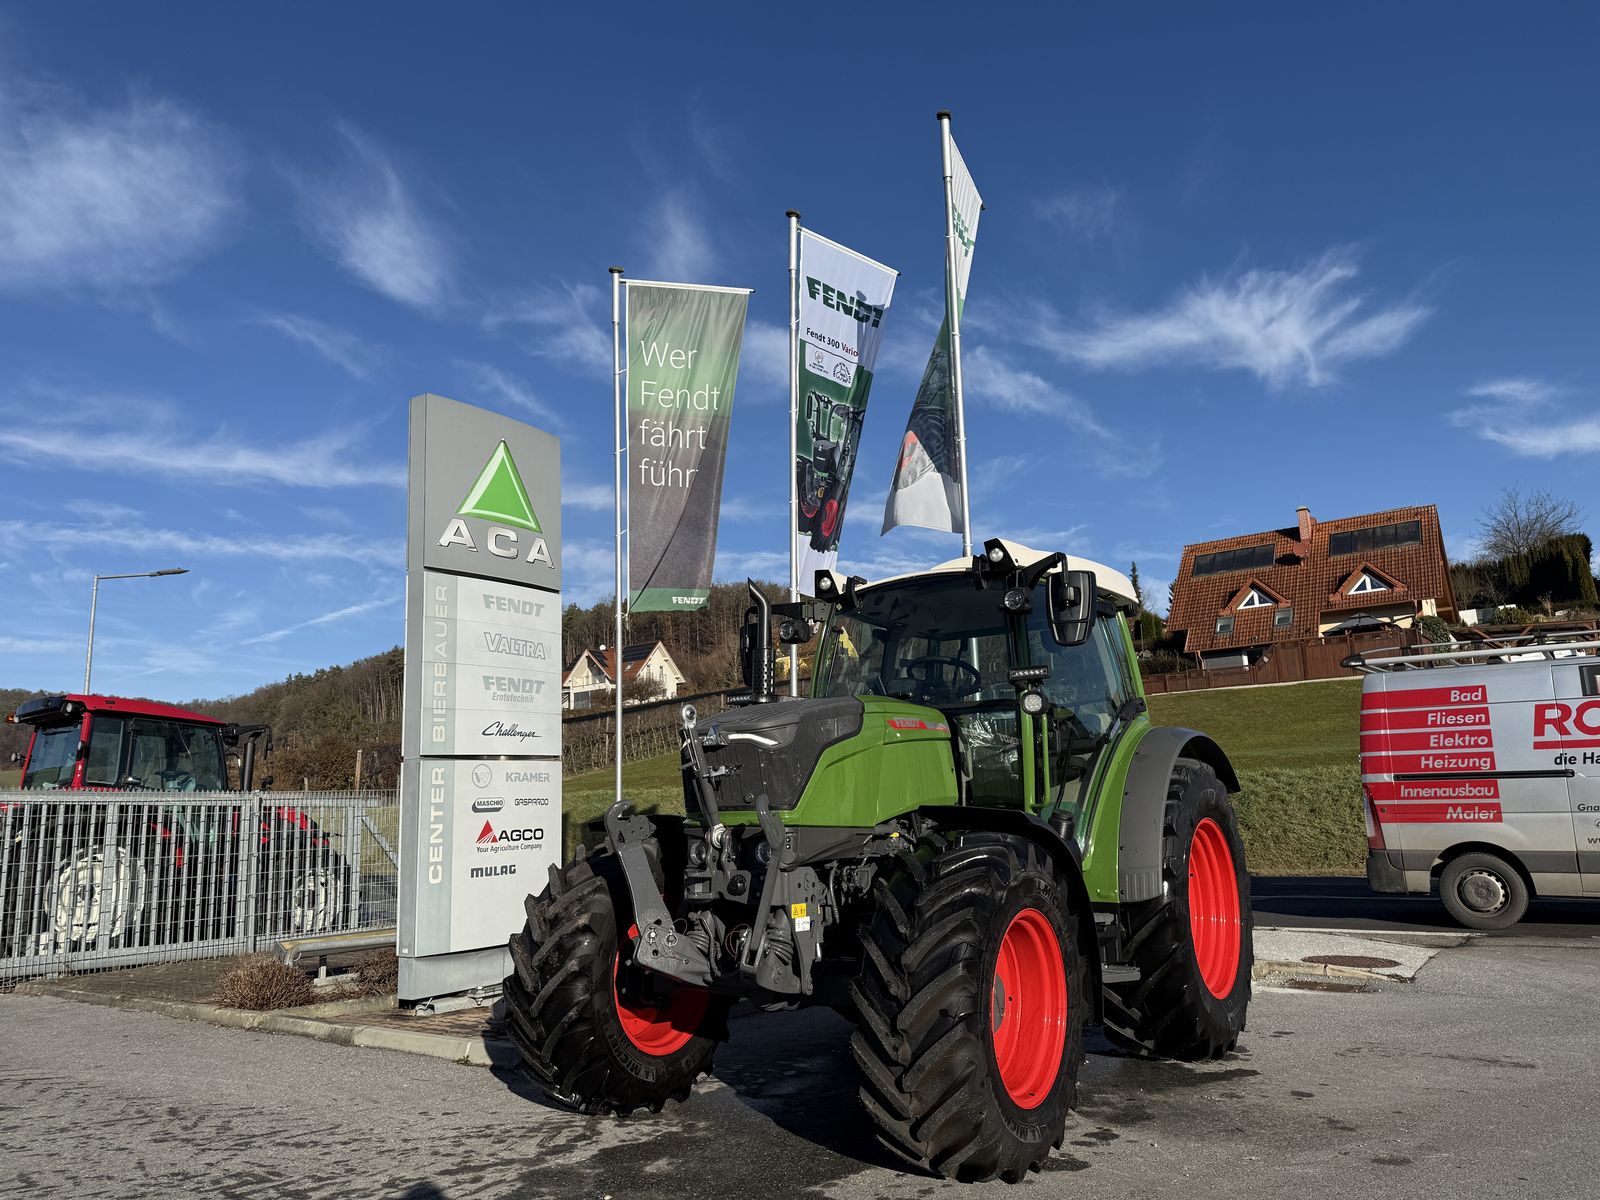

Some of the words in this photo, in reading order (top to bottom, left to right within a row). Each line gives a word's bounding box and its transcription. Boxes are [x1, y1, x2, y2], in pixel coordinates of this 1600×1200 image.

[806, 327, 826, 343] Fendt
[827, 337, 840, 349] 300
[841, 342, 859, 357] Vario
[640, 340, 697, 369] Wer
[641, 380, 720, 411] Fendt
[639, 419, 706, 449] fährt
[639, 458, 699, 488] führ
[437, 518, 555, 569] ACA
[482, 593, 545, 617] FENDT
[672, 596, 706, 605] FENDT
[484, 632, 546, 660] VALTRA
[432, 585, 448, 743] BIERBAUER
[482, 675, 545, 694] FENDT
[492, 692, 534, 703] Erntetechnik
[1450, 687, 1482, 702] Bad
[1427, 711, 1486, 726] Fliesen
[481, 721, 543, 743] Challenger
[1430, 733, 1489, 747] Elektro
[1420, 755, 1491, 770] Heizung
[1554, 752, 1577, 765] die
[505, 772, 551, 783] KRAMER
[1400, 783, 1494, 798] Innenausbau
[476, 799, 504, 807] MASCHIO
[514, 798, 549, 806] GASPARDO
[1446, 806, 1497, 820] Maler
[428, 767, 445, 884] CENTER
[498, 828, 544, 842] AGCO
[490, 844, 520, 853] Agriculture
[520, 843, 543, 851] Company
[470, 864, 517, 878] MULAG
